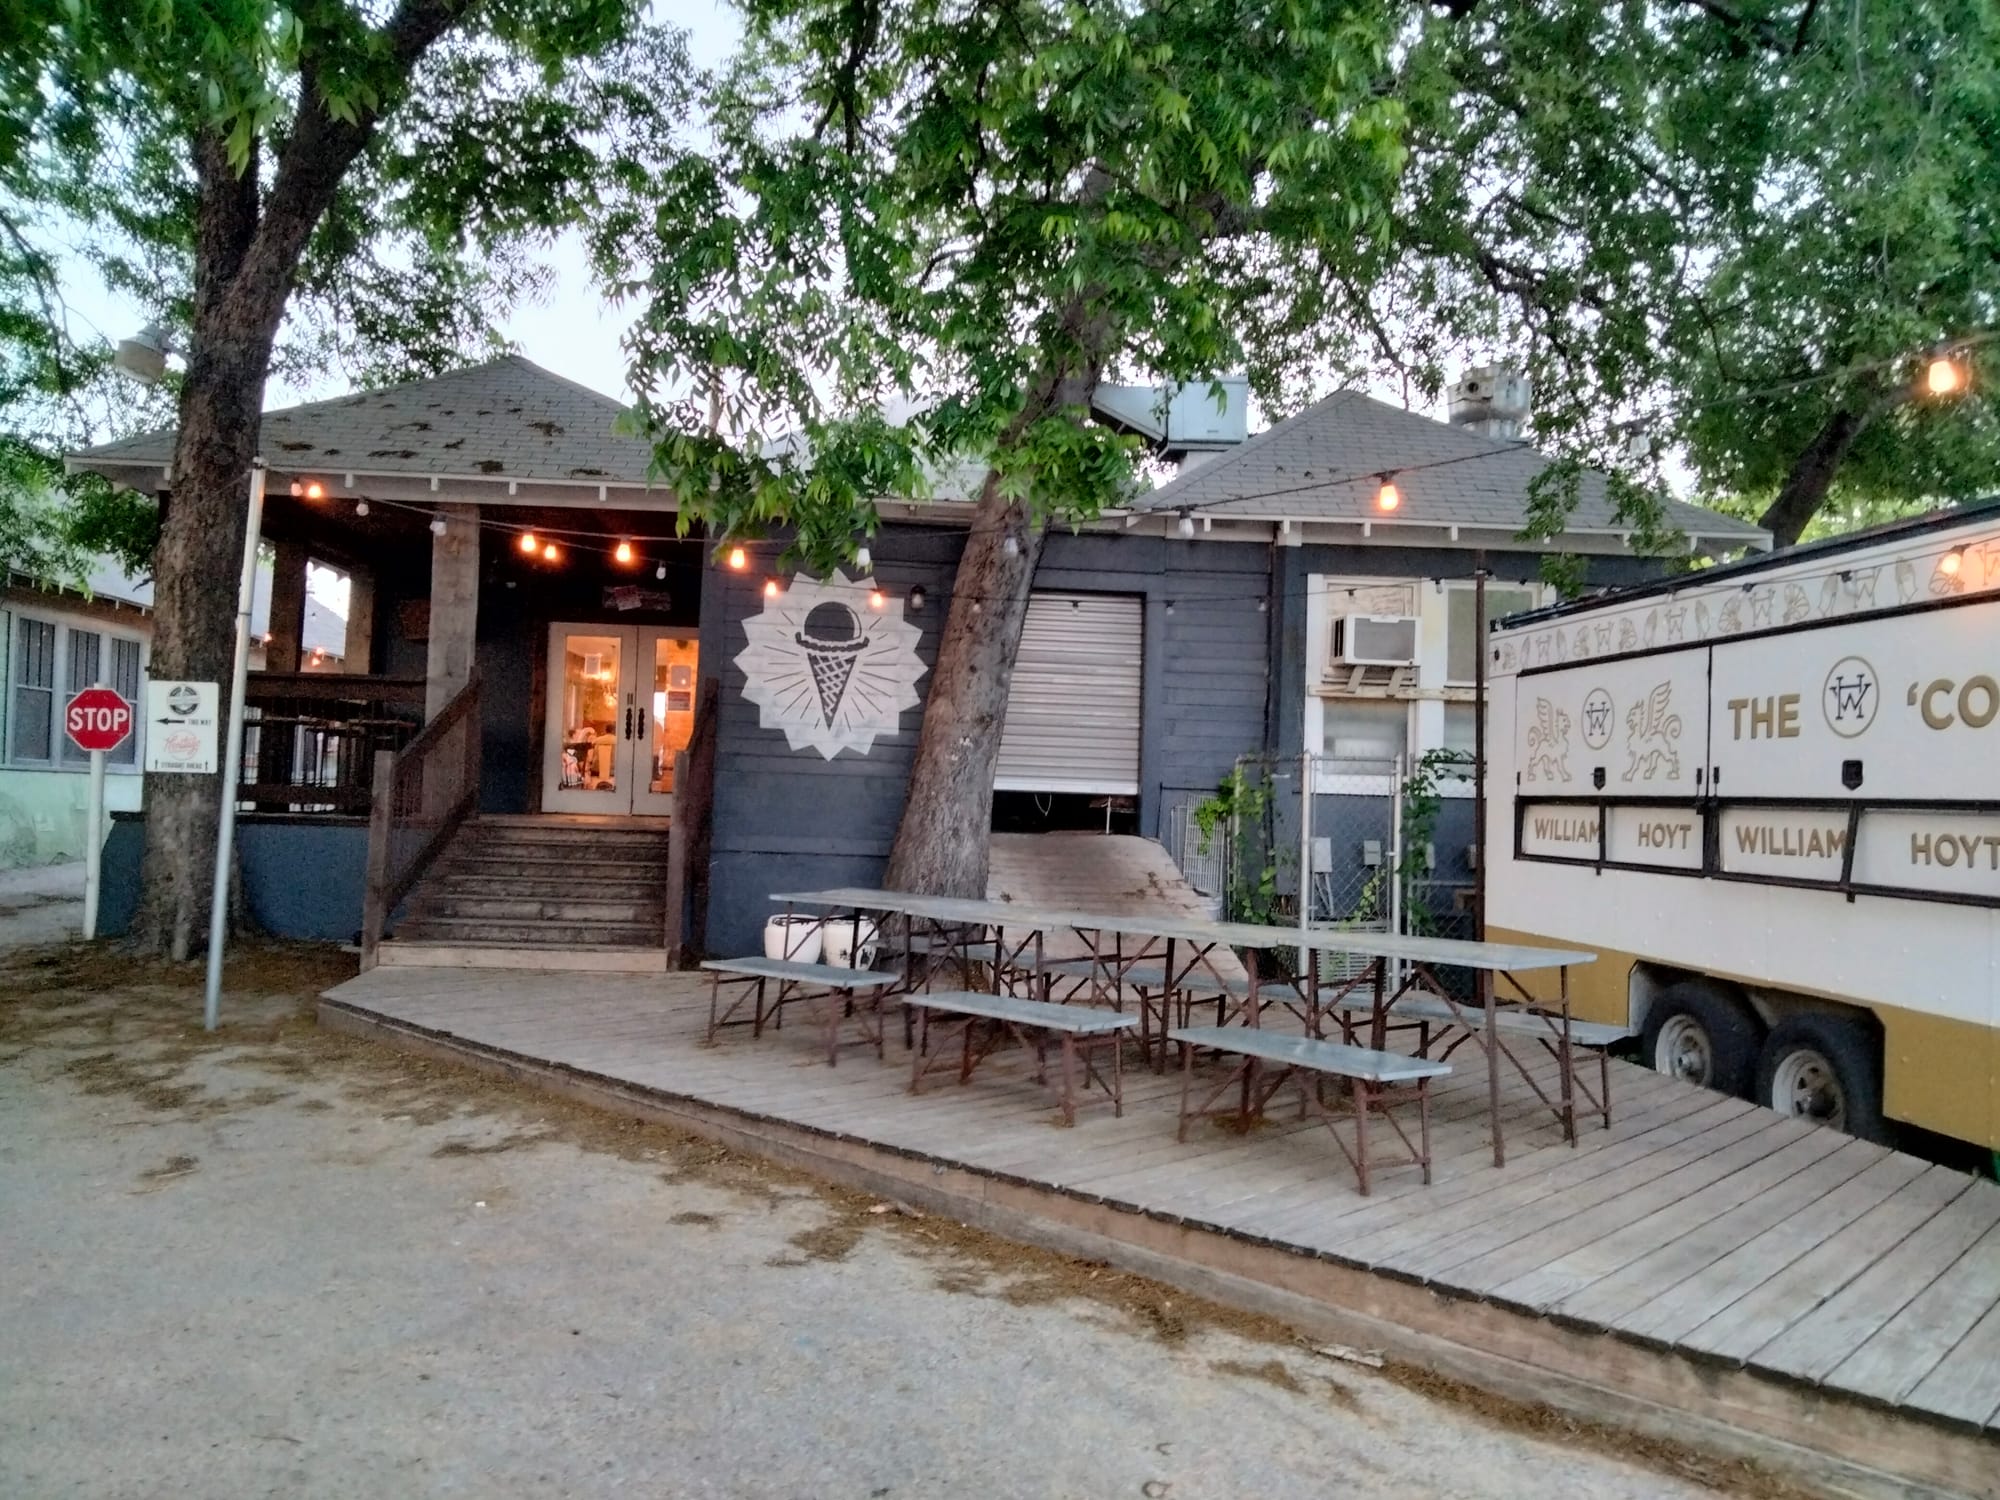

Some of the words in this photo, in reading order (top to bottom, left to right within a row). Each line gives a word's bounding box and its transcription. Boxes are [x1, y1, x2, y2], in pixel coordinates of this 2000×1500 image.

[69, 707, 129, 732] STOP
[1728, 693, 1801, 741] THE
[1534, 818, 1600, 844] WILLIAM
[1638, 823, 1692, 850] HOYT
[1735, 825, 1848, 859] WILLIAM
[1911, 832, 2000, 870] HOYT
